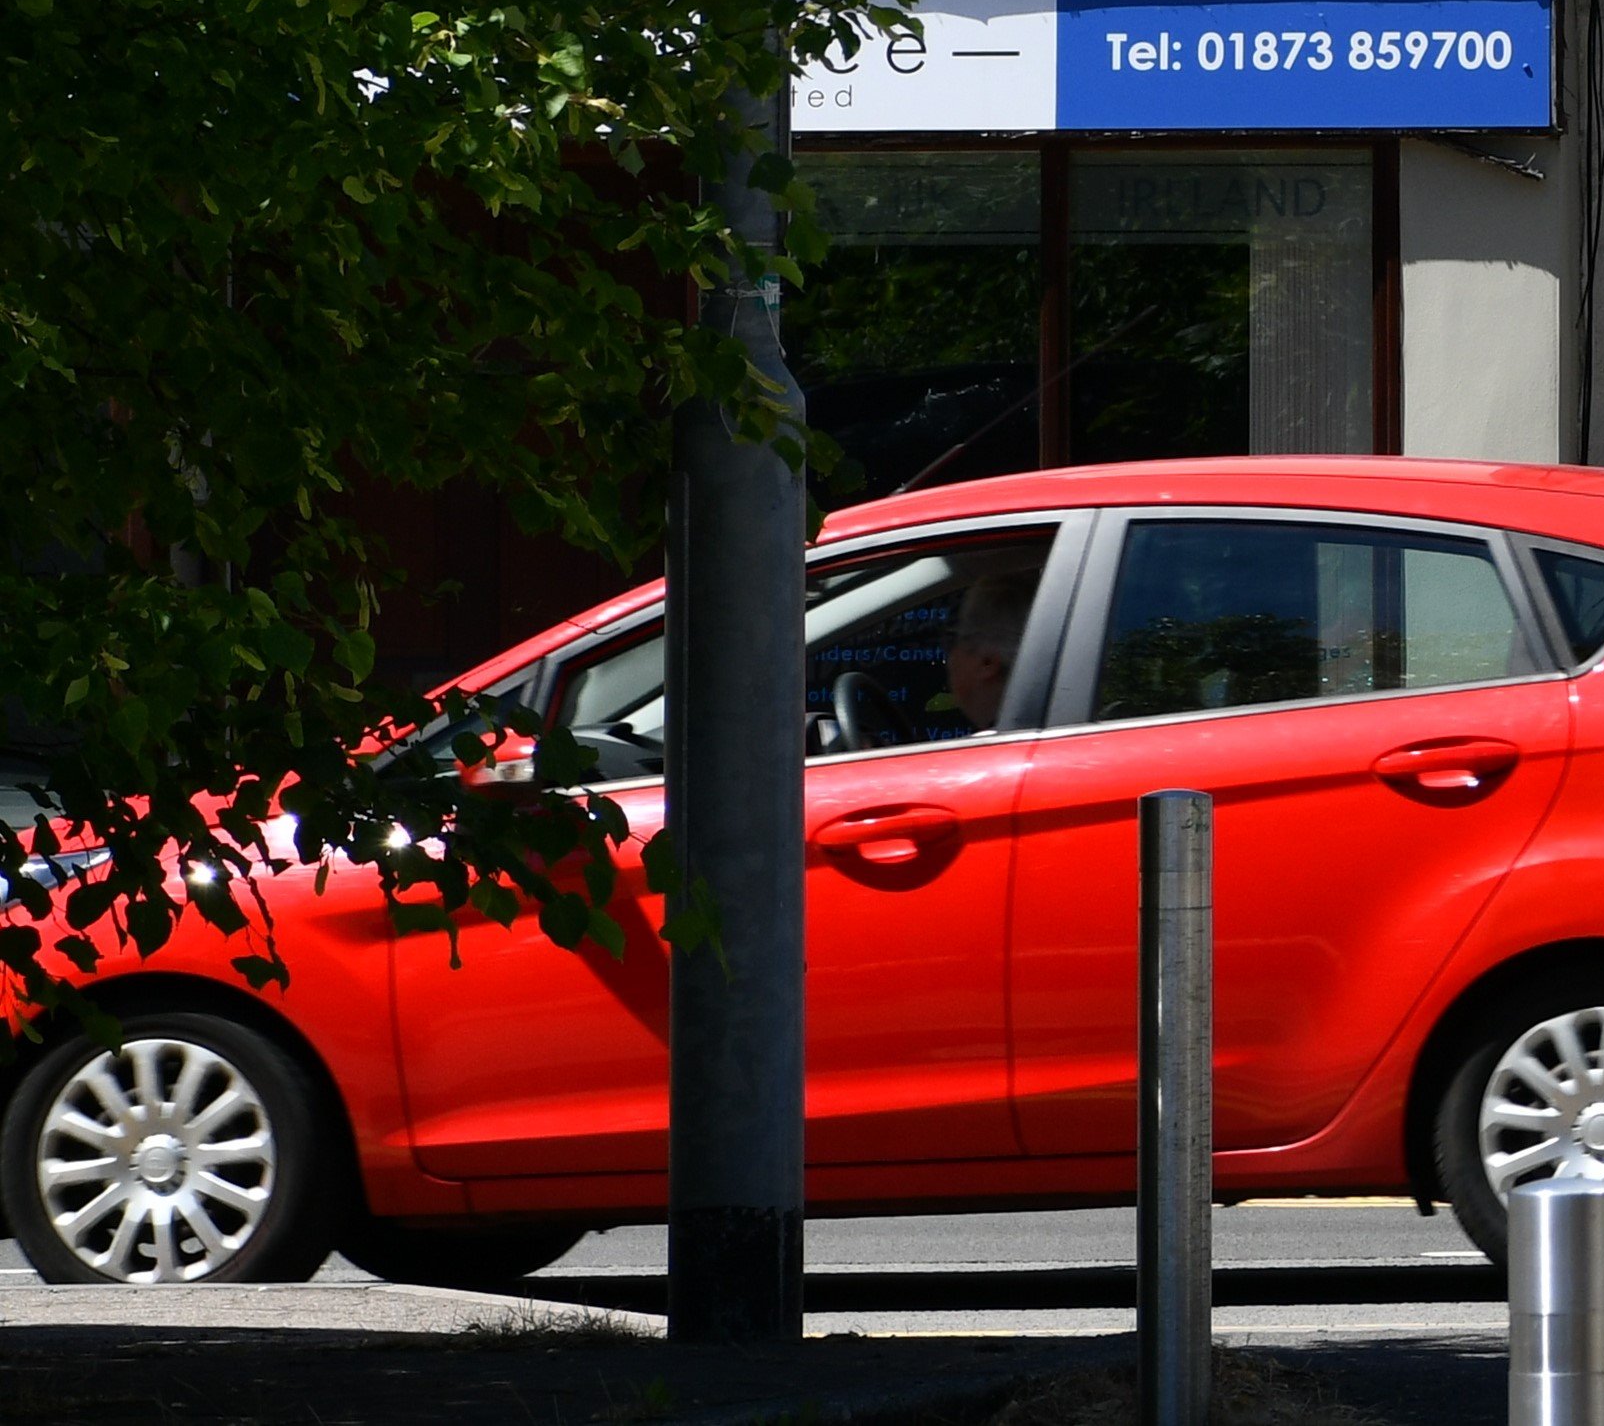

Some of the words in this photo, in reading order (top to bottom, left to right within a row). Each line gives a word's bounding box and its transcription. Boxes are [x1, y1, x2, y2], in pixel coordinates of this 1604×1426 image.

[1107, 33, 1182, 71] Tel:
[1198, 31, 1333, 71] 01873
[1348, 30, 1512, 71] 859700
